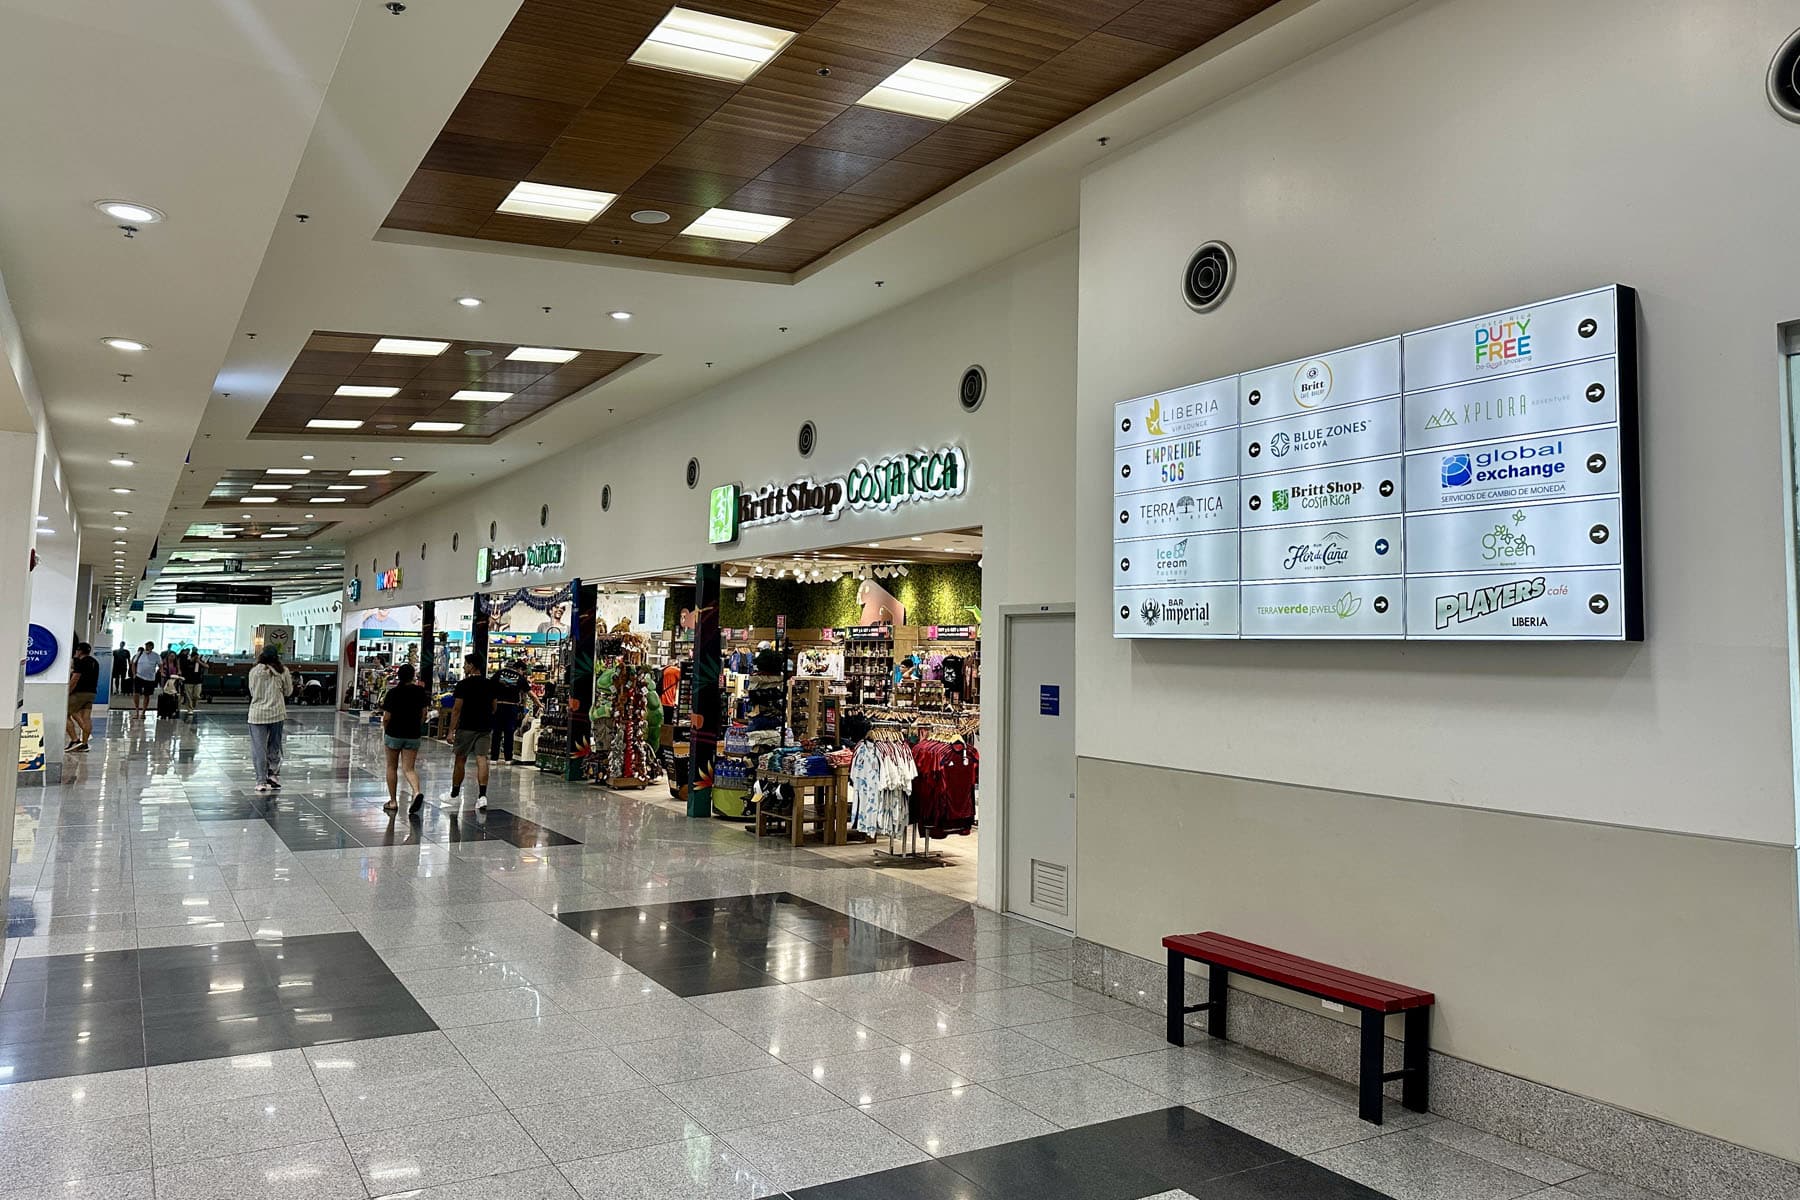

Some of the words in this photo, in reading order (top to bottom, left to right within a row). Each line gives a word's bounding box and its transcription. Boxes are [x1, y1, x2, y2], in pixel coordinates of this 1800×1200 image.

[1475, 318, 1531, 345] DUTY
[1475, 335, 1532, 364] FREE
[1301, 381, 1324, 392] Britt
[1163, 399, 1219, 422] LIBERIA
[1463, 394, 1527, 424] XPLORA
[1293, 428, 1323, 443] BLUE
[1294, 440, 1328, 452] NICOYA
[1146, 439, 1202, 465] EMPRENDE
[1476, 440, 1562, 467] global
[1161, 461, 1184, 484] 506
[1476, 462, 1566, 482] exchange
[738, 486, 787, 523] Britt
[785, 481, 841, 515] Shop
[846, 462, 906, 504] COSTA
[1291, 484, 1325, 498] Britt
[1326, 481, 1362, 494] Shop
[1441, 493, 1476, 503] SERVICIOS
[1476, 492, 1486, 500] DE
[1487, 489, 1517, 499] CAMBIO
[1530, 484, 1566, 494] MONEDA
[1139, 502, 1176, 519] TERRA
[1196, 496, 1223, 513] TICA
[1301, 497, 1328, 509] COSTA
[1156, 548, 1173, 560] Ice
[1156, 559, 1188, 569] cream
[1283, 544, 1314, 570] Flor
[1313, 549, 1323, 560] de
[1322, 542, 1349, 566] Caña
[1161, 602, 1210, 625] Imperial
[1168, 598, 1184, 607] BAR
[1435, 576, 1546, 630] PLAYERS
[1547, 584, 1569, 596] café
[1511, 617, 1549, 627] LIBERIA
